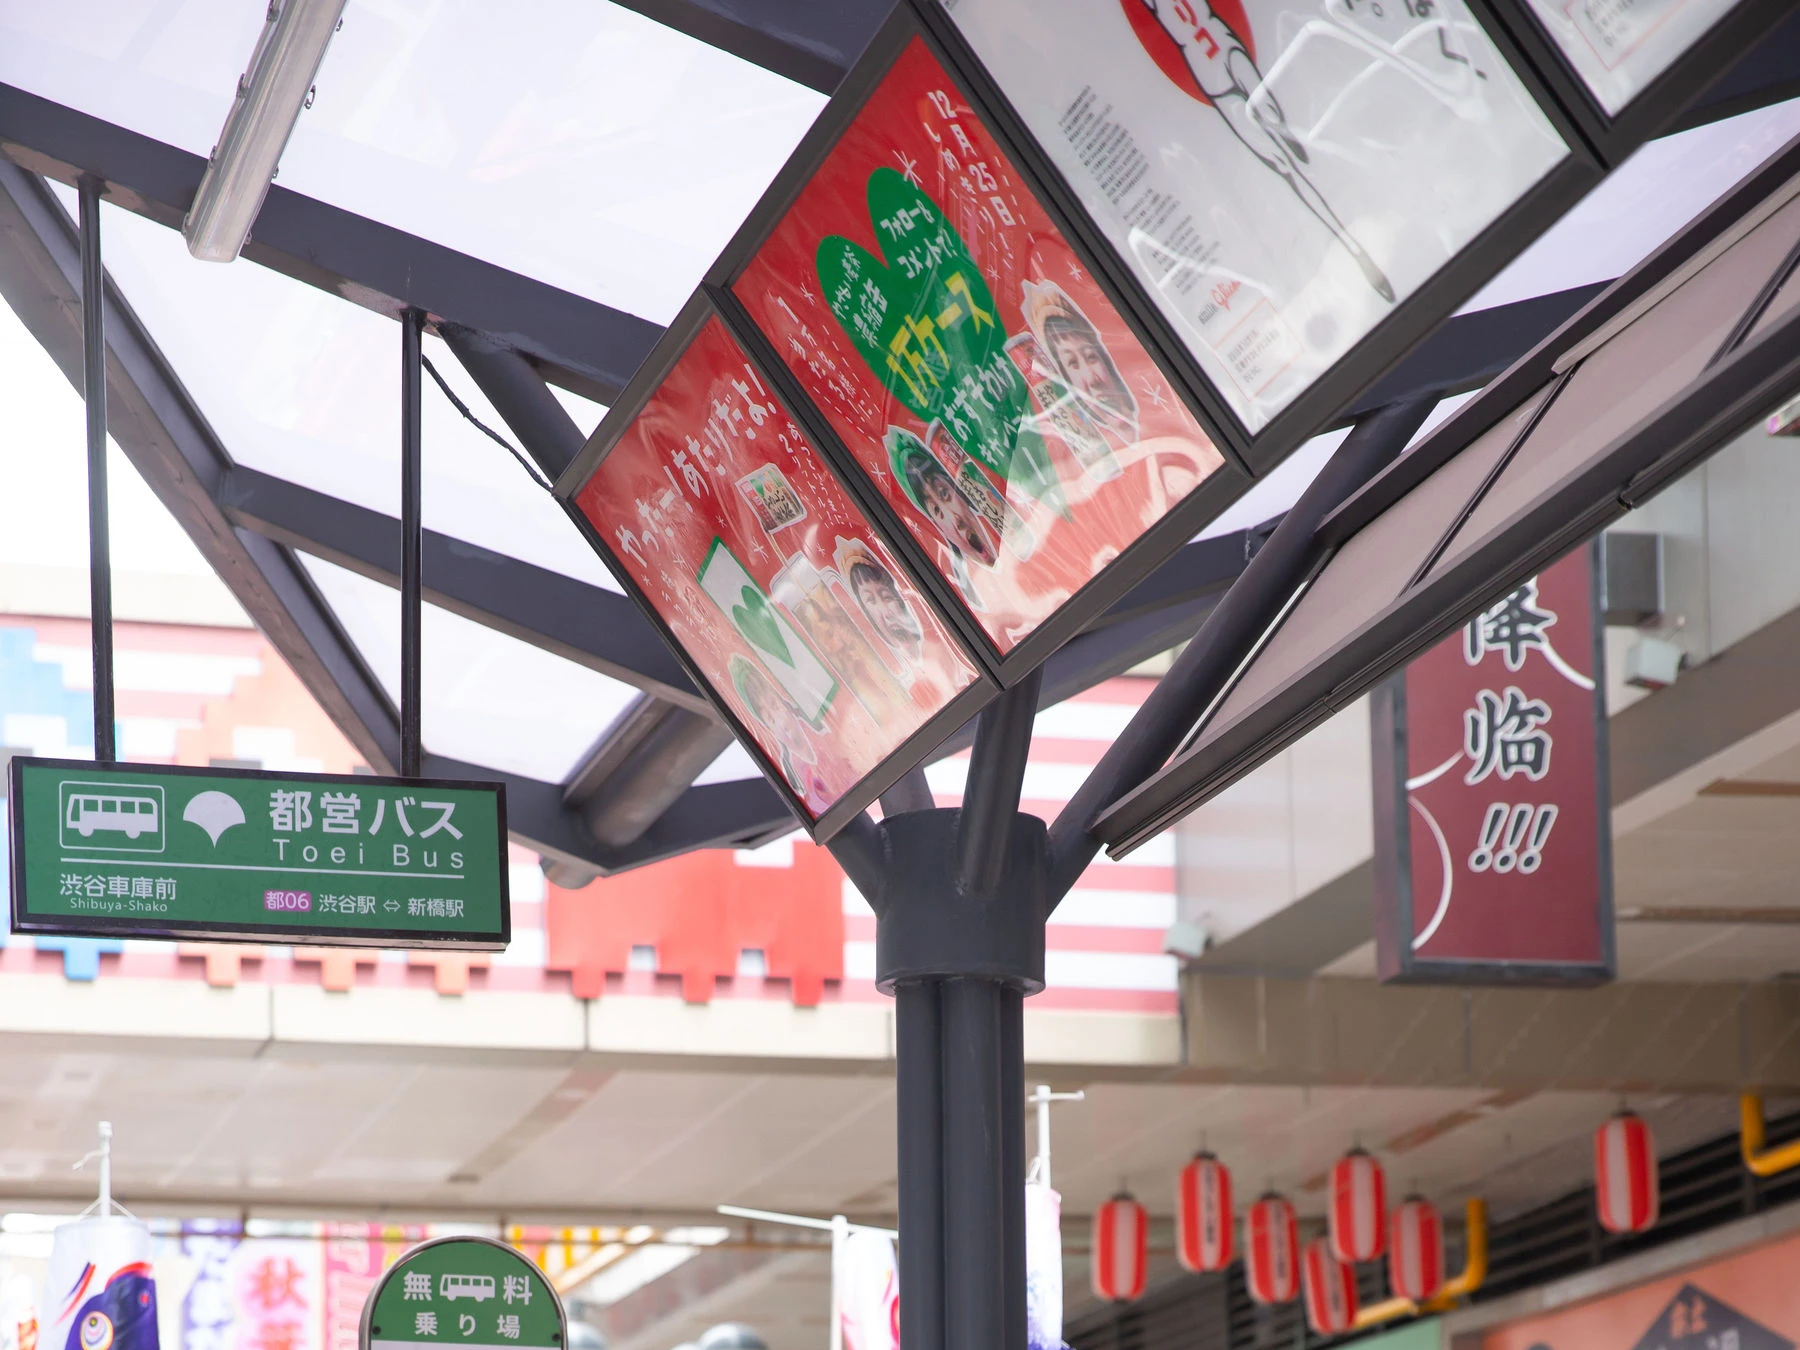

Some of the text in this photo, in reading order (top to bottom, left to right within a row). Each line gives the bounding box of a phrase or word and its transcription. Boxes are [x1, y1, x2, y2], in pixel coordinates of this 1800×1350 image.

[928, 91, 1016, 226] 12月25日
[943, 352, 1016, 441] おすそわけ
[269, 788, 464, 839] 都営バス
[272, 838, 465, 869] Toei Bus
[59, 873, 177, 900] 渋谷車庫前
[69, 897, 168, 914] Shibuya-Shako
[267, 890, 464, 918] 都06 渋谷駅 新橋駅
